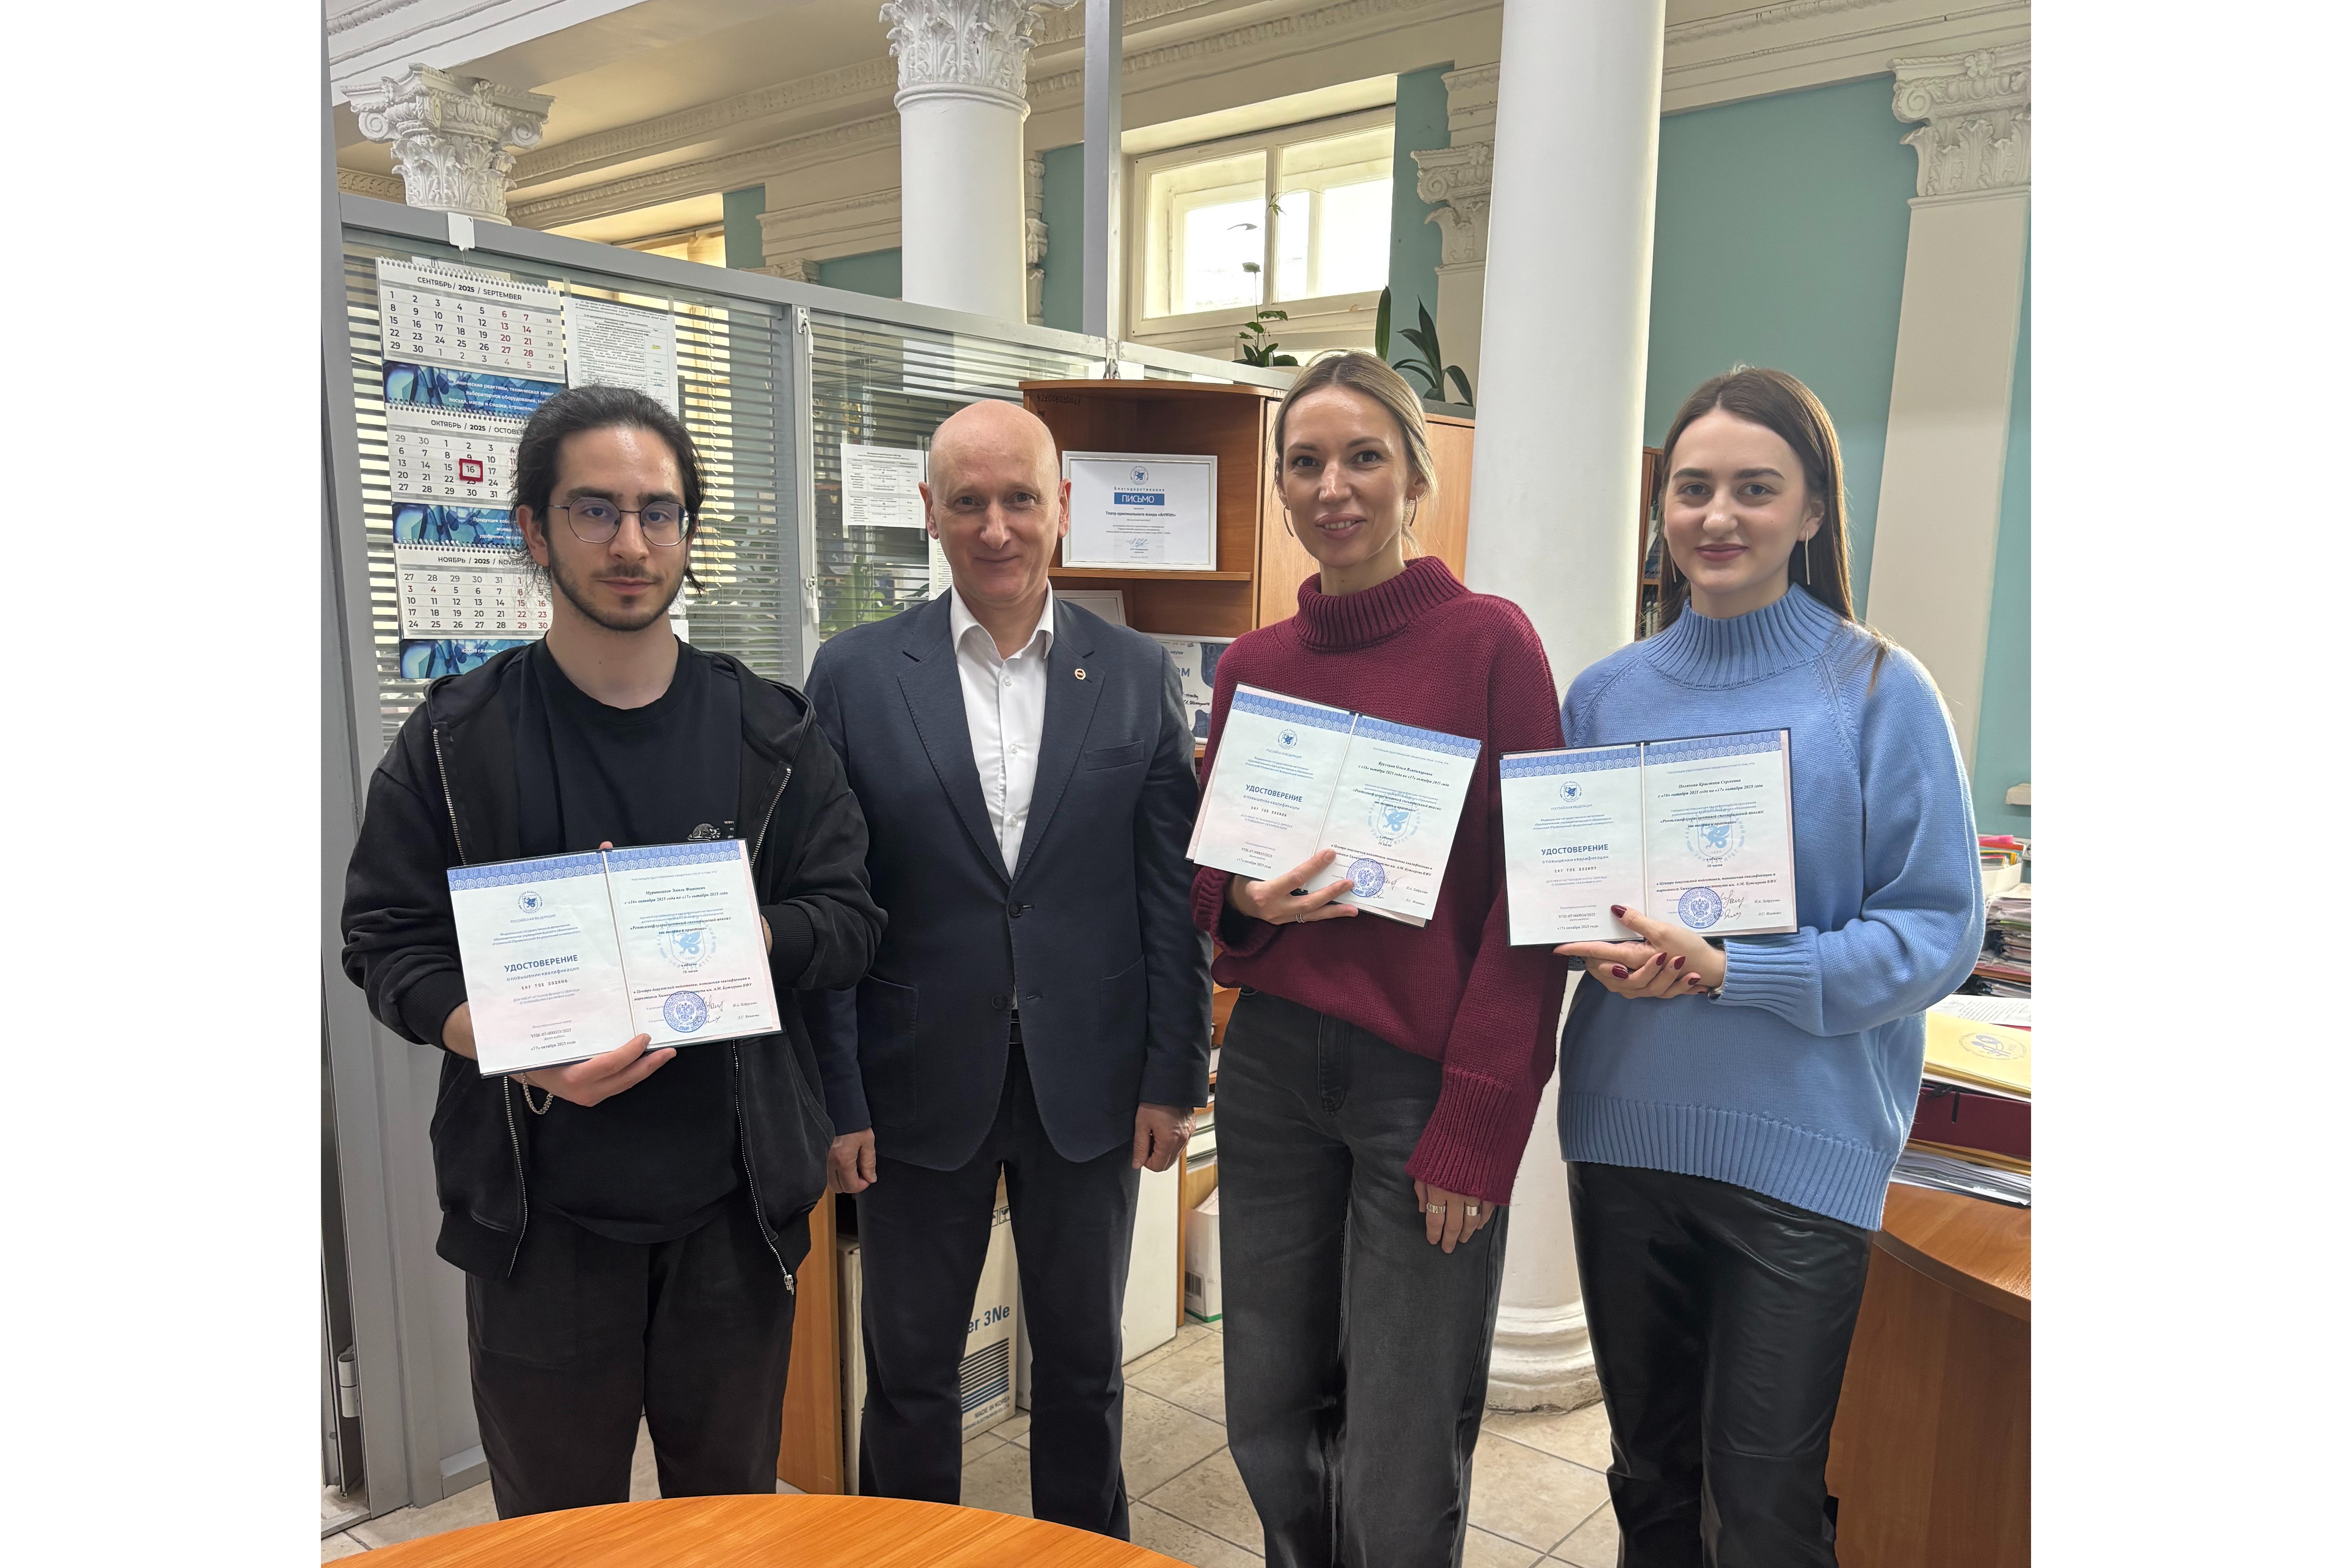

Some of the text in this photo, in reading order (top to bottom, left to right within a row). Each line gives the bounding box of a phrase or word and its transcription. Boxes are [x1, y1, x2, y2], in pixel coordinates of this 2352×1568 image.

[418, 277, 452, 289] СЕНТЯБРЬ
[483, 289, 522, 301] SEPTEMBER
[1122, 495, 1154, 503] ПИСЬМО
[1246, 784, 1303, 802] УДОСТОВЕРЕНИЕ
[1270, 801, 1300, 810] квалификации
[1541, 844, 1608, 855] УДОСТОВЕРЕНИЕ
[505, 955, 578, 972] УДОСТОВЕРЕНИЕ
[542, 967, 579, 976] квалификации
[984, 1305, 1010, 1326] 3Ne
[974, 1408, 988, 1418] MADE
[994, 1396, 1010, 1408] KOREA
